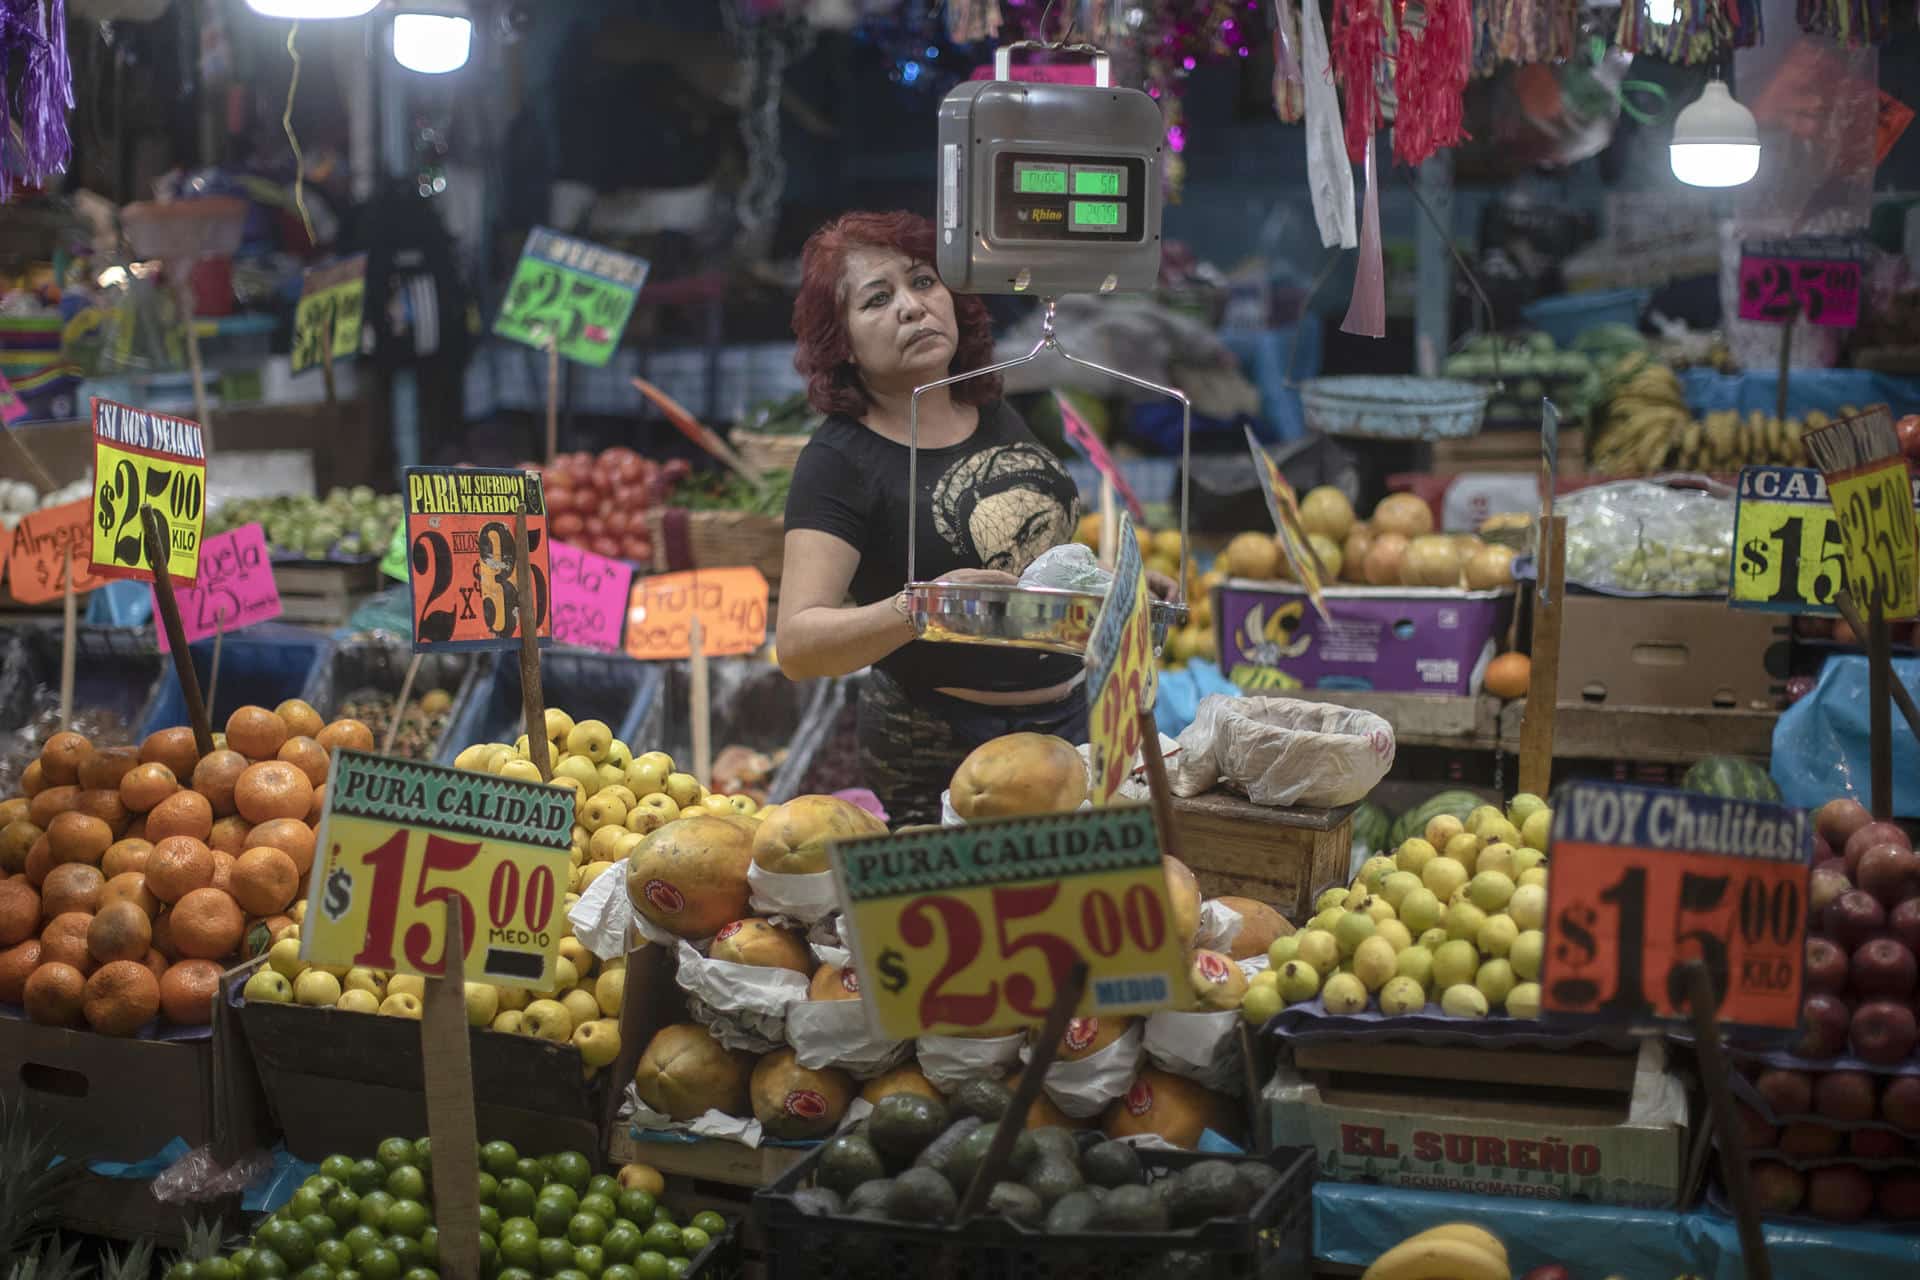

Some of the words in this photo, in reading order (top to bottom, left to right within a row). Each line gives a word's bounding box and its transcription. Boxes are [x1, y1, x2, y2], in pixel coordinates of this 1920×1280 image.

[1031, 207, 1063, 222] Rhino
[120, 407, 148, 448] NOS
[409, 473, 460, 513] PARA
[459, 475, 472, 494] MI
[171, 529, 196, 551] KILO
[413, 530, 457, 643] 2
[344, 770, 427, 810] PURA
[437, 786, 567, 832] CALIDAD
[1648, 796, 1808, 859] Chulitas!
[857, 843, 960, 881] PURA
[971, 821, 1145, 866] CALIDAD
[489, 928, 551, 947] MEDIO
[1094, 975, 1168, 1007] MEDIO
[1741, 956, 1792, 990] KILO
[1340, 1124, 1398, 1159] EL
[1412, 1130, 1601, 1176] SUREÑO
